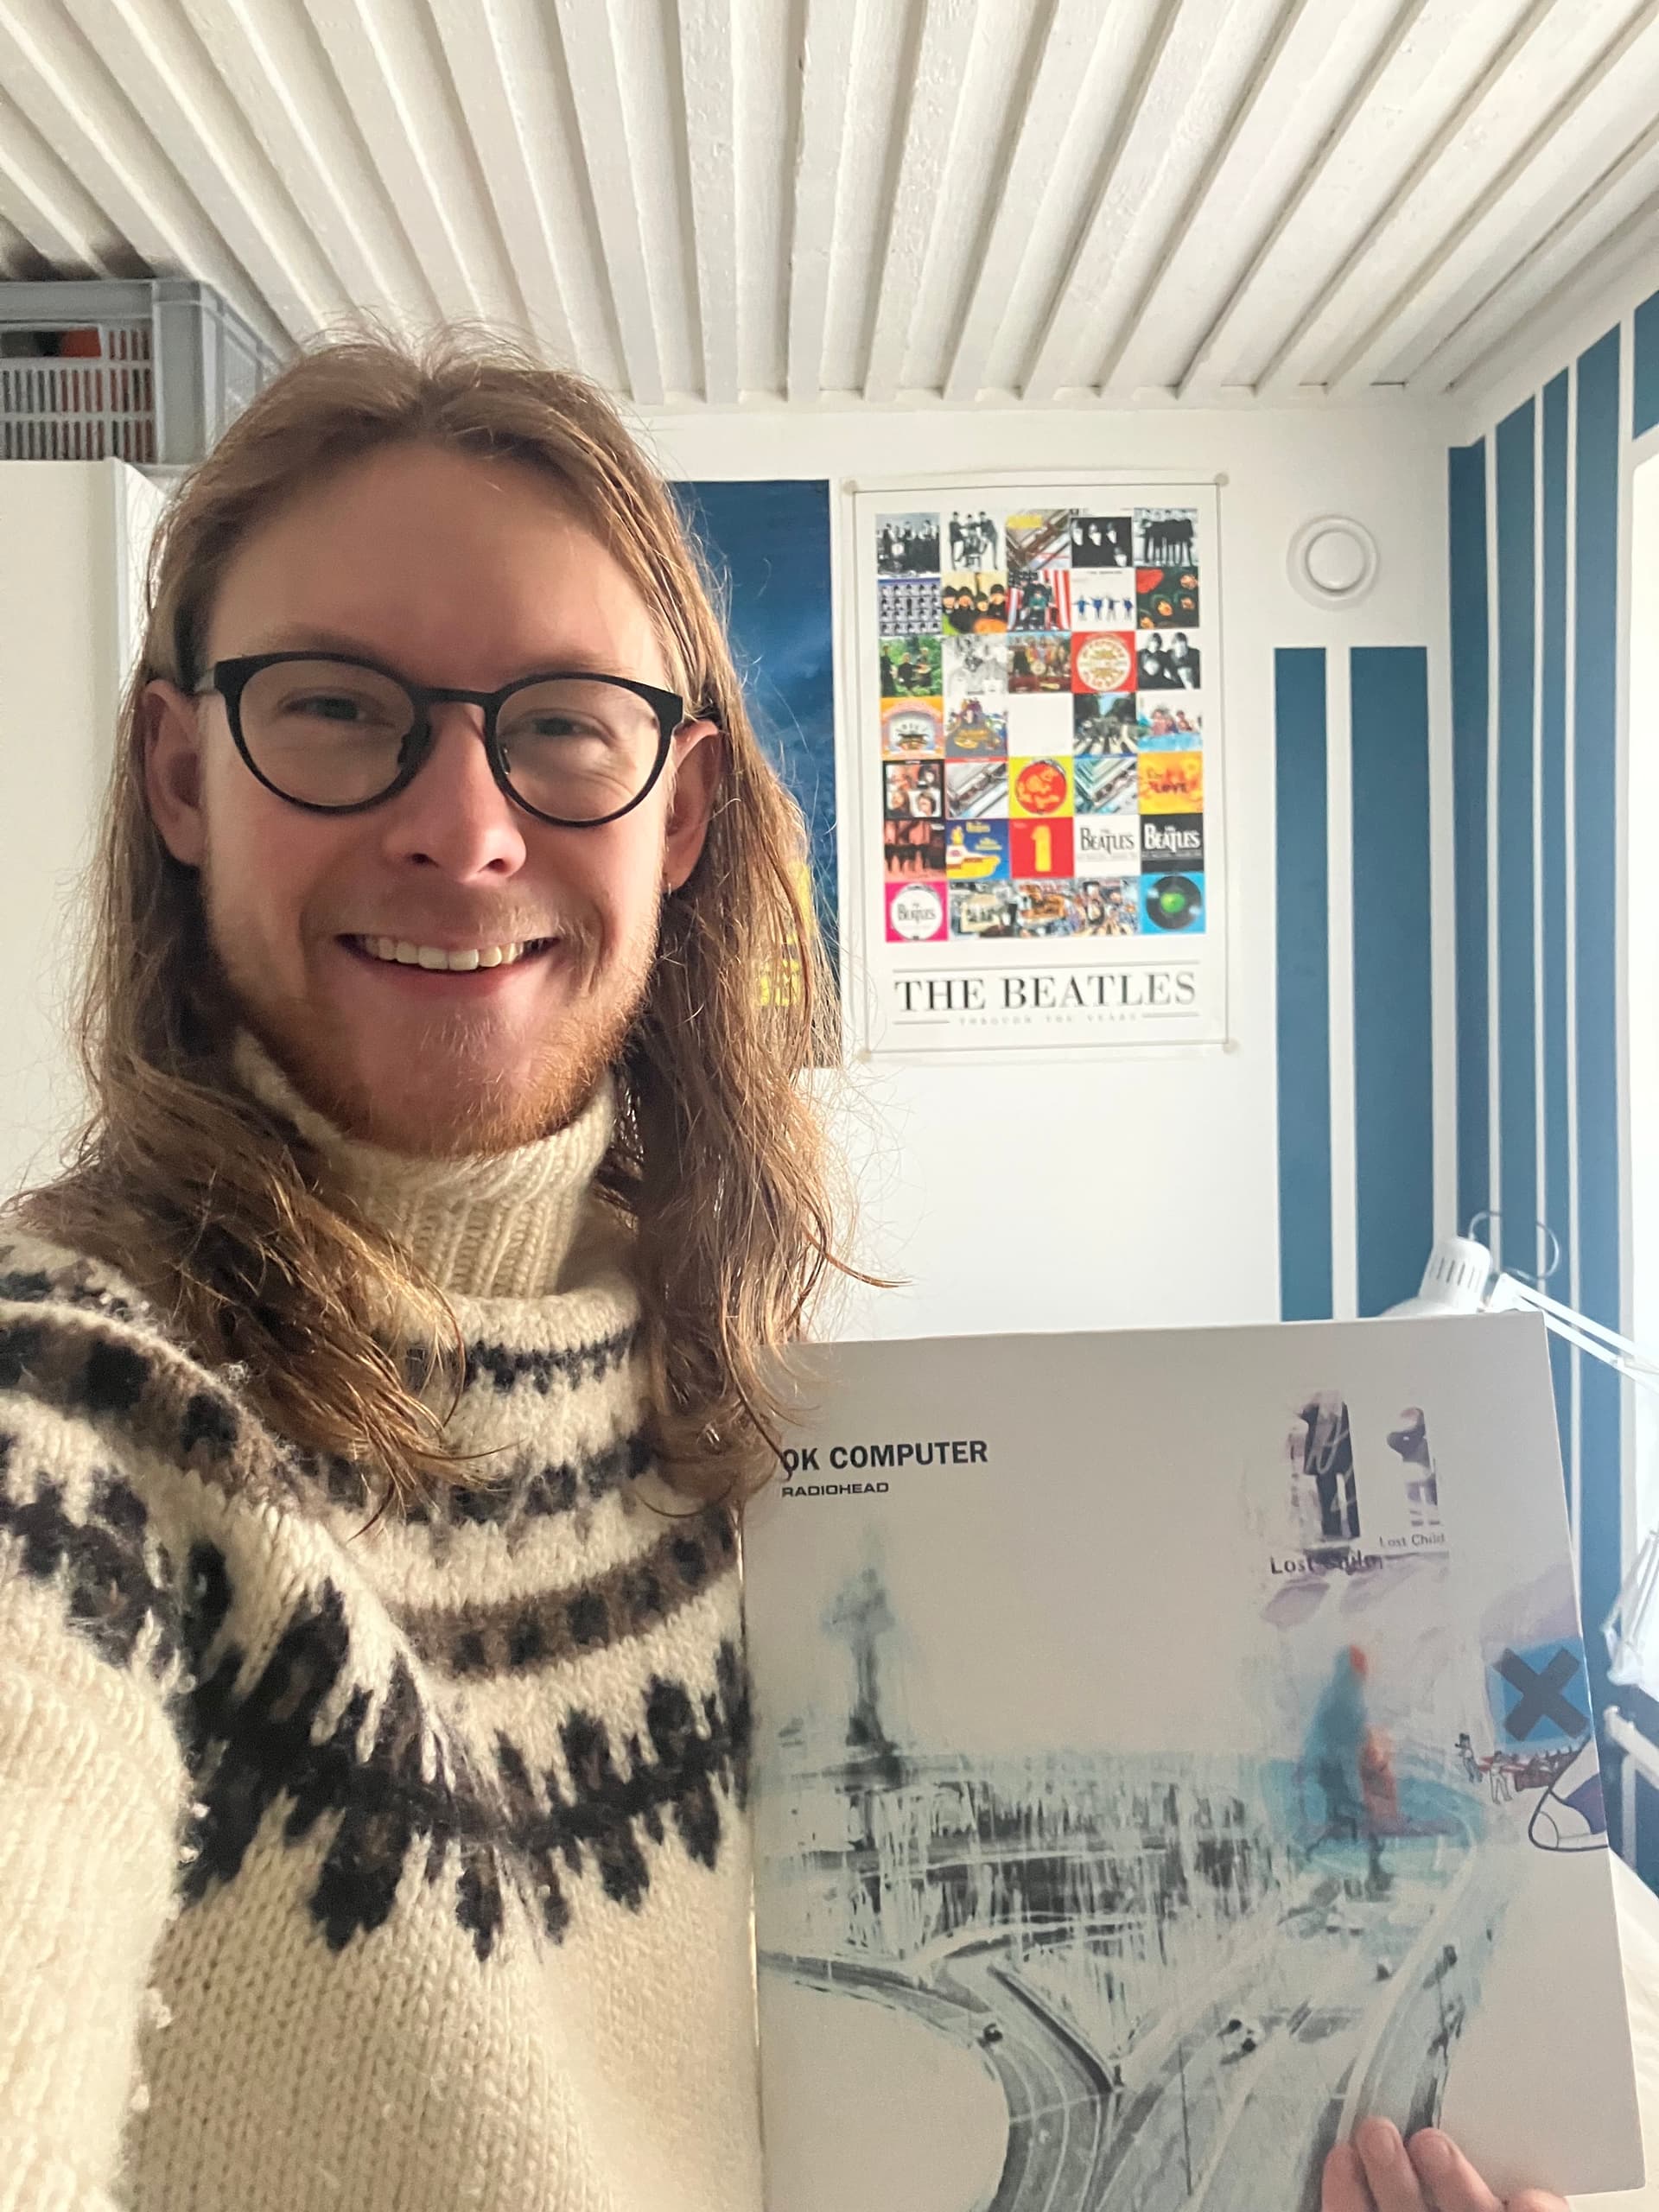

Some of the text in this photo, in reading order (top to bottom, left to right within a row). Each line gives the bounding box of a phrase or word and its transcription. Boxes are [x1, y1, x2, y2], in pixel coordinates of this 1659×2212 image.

[1031, 824, 1052, 873] 1
[893, 971, 1196, 1013] THE BEATLES
[782, 1440, 988, 1471] OK COMPUTER
[781, 1481, 890, 1498] RADIOHEAD
